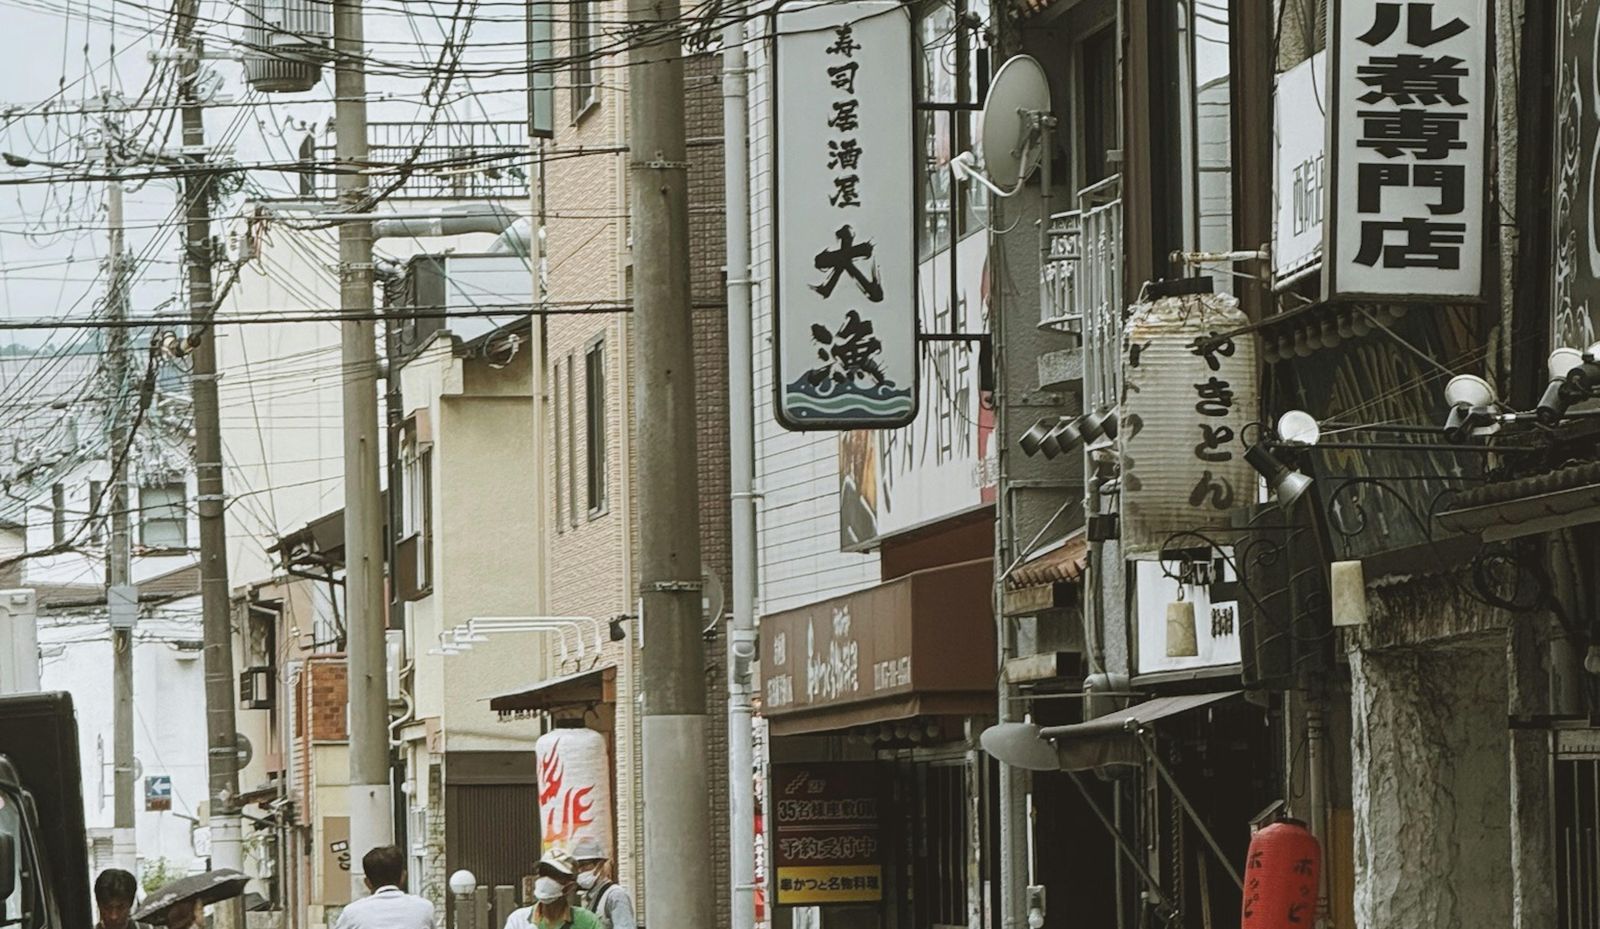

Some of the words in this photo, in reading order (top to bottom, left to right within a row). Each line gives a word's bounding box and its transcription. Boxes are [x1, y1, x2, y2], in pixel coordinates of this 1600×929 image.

[825, 23, 863, 208] 寿司居酒屋
[1353, 3, 1470, 270] ル煮専門店
[808, 224, 885, 386] 大漁
[1185, 331, 1235, 509] やきとん
[779, 836, 877, 859] 予約受付中
